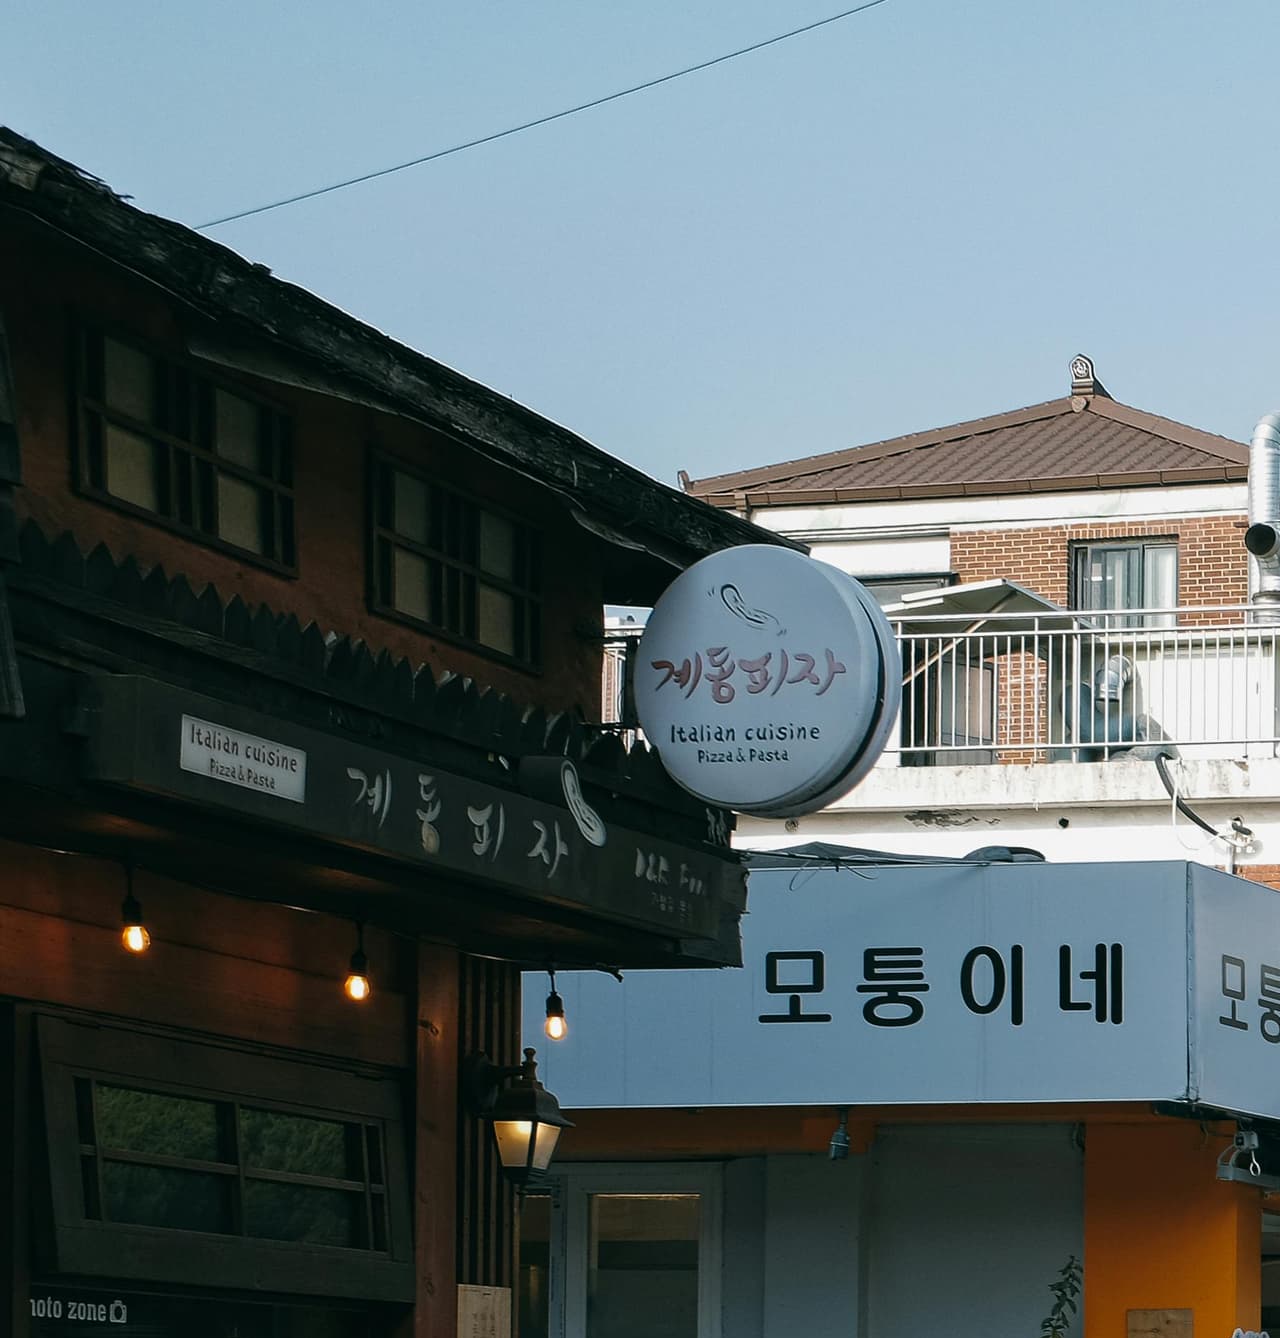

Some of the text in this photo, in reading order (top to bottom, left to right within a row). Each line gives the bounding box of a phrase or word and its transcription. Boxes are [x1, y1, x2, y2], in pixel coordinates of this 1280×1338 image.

[650, 646, 847, 704] 계동피자
[190, 723, 298, 773] Italian cuisine
[670, 722, 821, 744] Italian cuisine
[346, 767, 568, 879] 계동피자
[757, 942, 1125, 1027] 모퉁이네
[67, 1301, 107, 1322] zone
